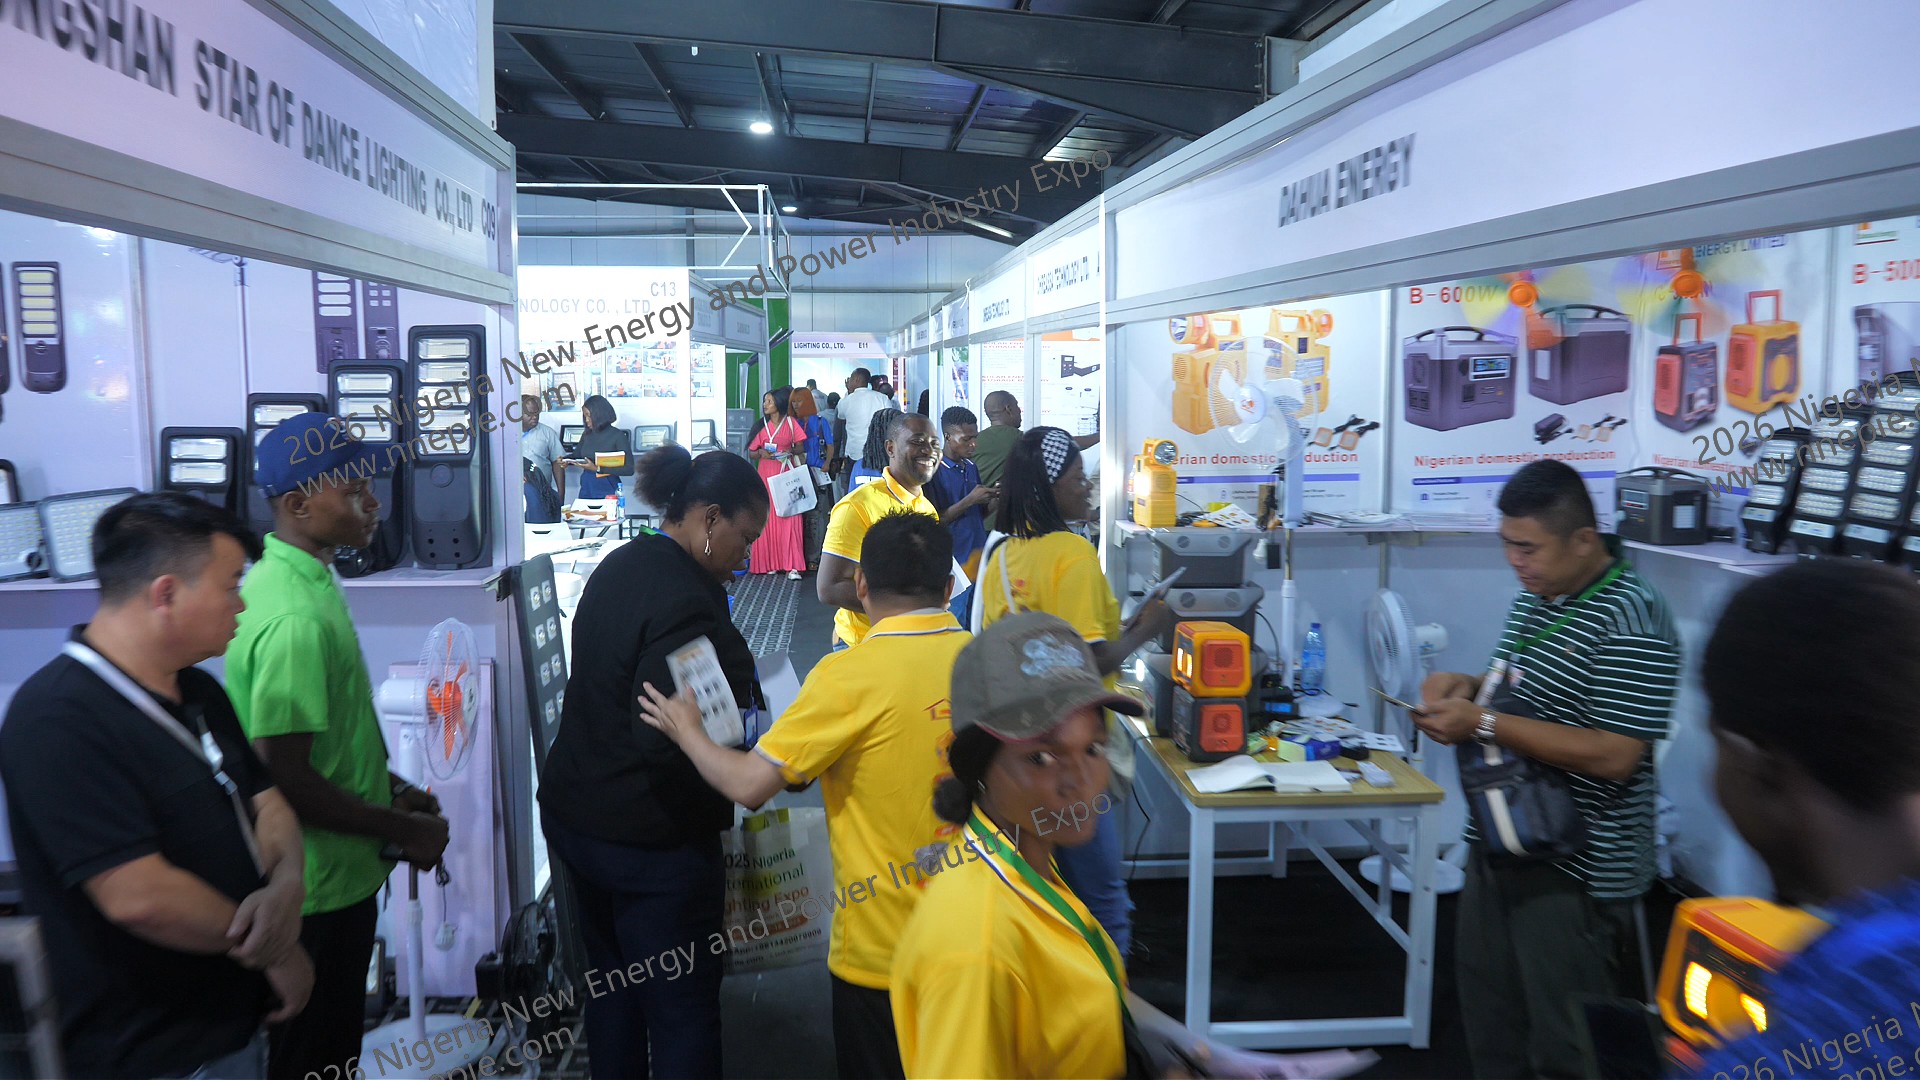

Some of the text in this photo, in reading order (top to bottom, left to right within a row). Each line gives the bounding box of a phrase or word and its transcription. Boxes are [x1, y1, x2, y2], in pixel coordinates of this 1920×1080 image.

[194, 38, 262, 136] STAR
[267, 79, 294, 149] OF
[302, 100, 361, 182] DANCE
[365, 136, 427, 215] LIGHTING
[481, 198, 496, 241] C09
[1278, 132, 1417, 228] DAHUA ENERGY
[650, 282, 677, 297] C13
[519, 299, 580, 314] NOLOGY
[1175, 451, 1358, 465] erian domestic duction
[1414, 454, 1474, 468] Nigerian
[1477, 452, 1539, 465] domestic
[724, 848, 796, 869] 025 Nigeria
[726, 863, 804, 891] ternational
